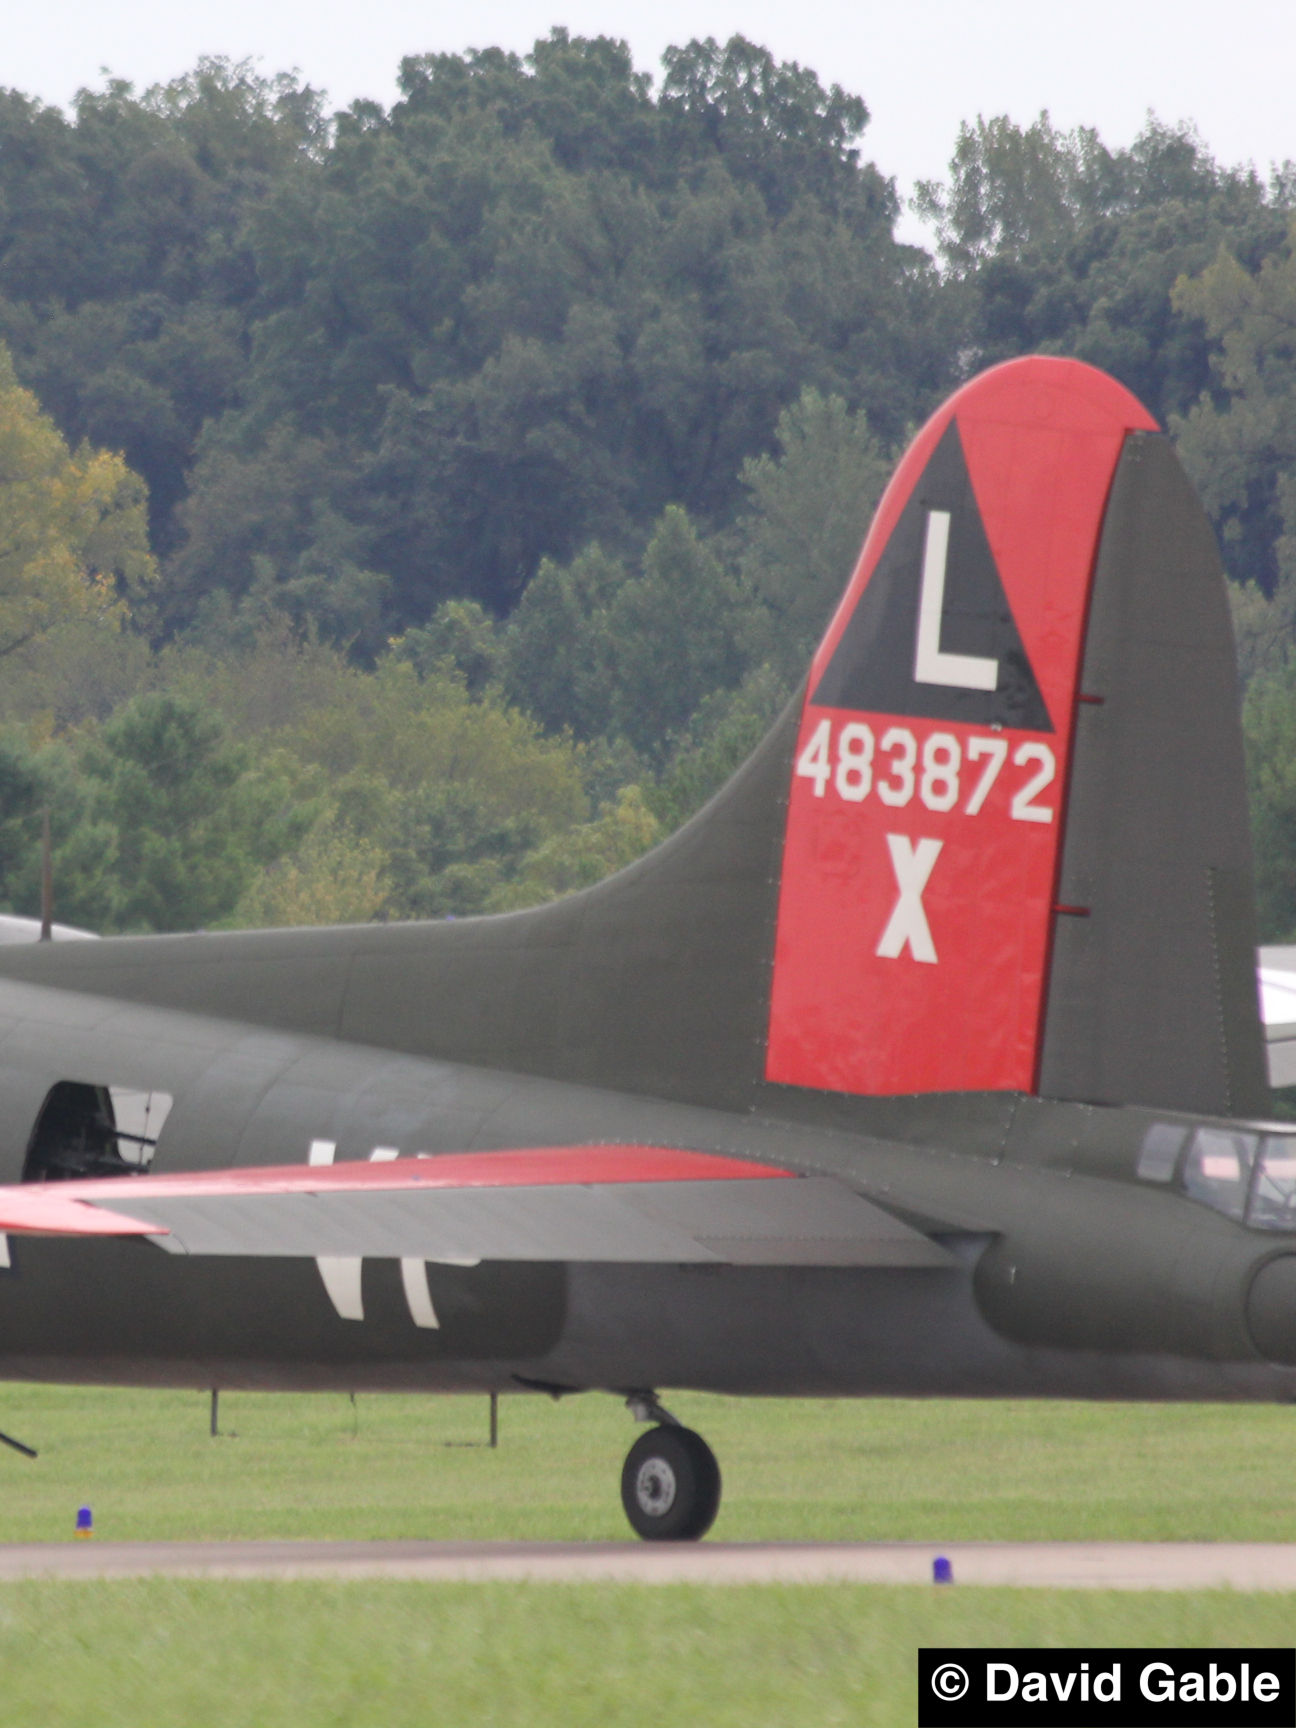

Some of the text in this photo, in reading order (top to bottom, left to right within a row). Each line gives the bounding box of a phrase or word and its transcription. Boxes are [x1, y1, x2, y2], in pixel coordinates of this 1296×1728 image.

[914, 510, 999, 691] L
[796, 719, 1056, 823] 483872
[875, 832, 944, 964] X
